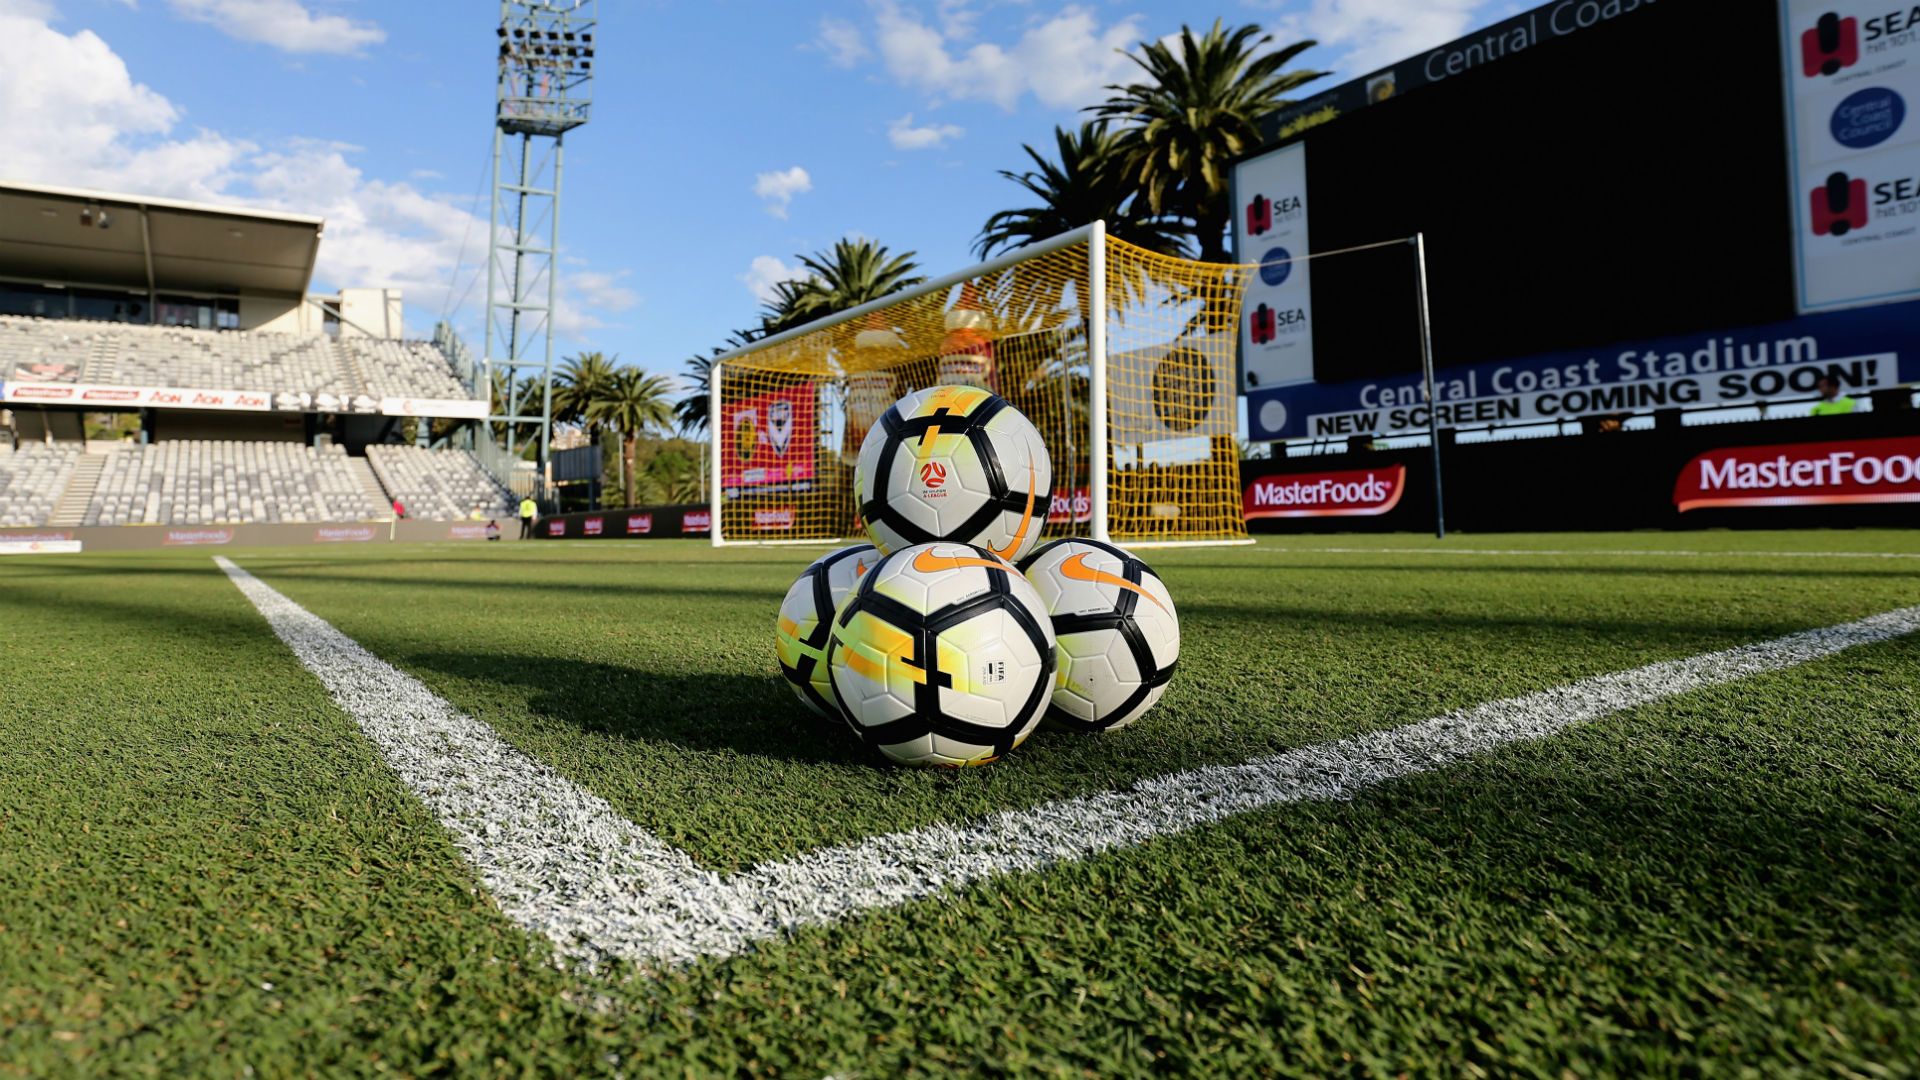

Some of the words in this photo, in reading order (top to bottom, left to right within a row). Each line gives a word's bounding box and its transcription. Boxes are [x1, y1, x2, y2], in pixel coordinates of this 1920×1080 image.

[1424, 14, 1537, 82] Central
[1550, 0, 1656, 35] Coa
[1274, 196, 1303, 216] SEA
[1874, 177, 1920, 205] SE
[1278, 308, 1306, 326] SEA
[1360, 370, 1476, 409] Central
[1492, 359, 1600, 394] Coast
[1617, 336, 1817, 381] Stadium
[1316, 412, 1379, 436] NEW
[1390, 397, 1520, 430] SCREEN
[1535, 379, 1699, 416] COMING
[1718, 359, 1878, 399] SOON!
[1254, 473, 1386, 505] MasterFoods
